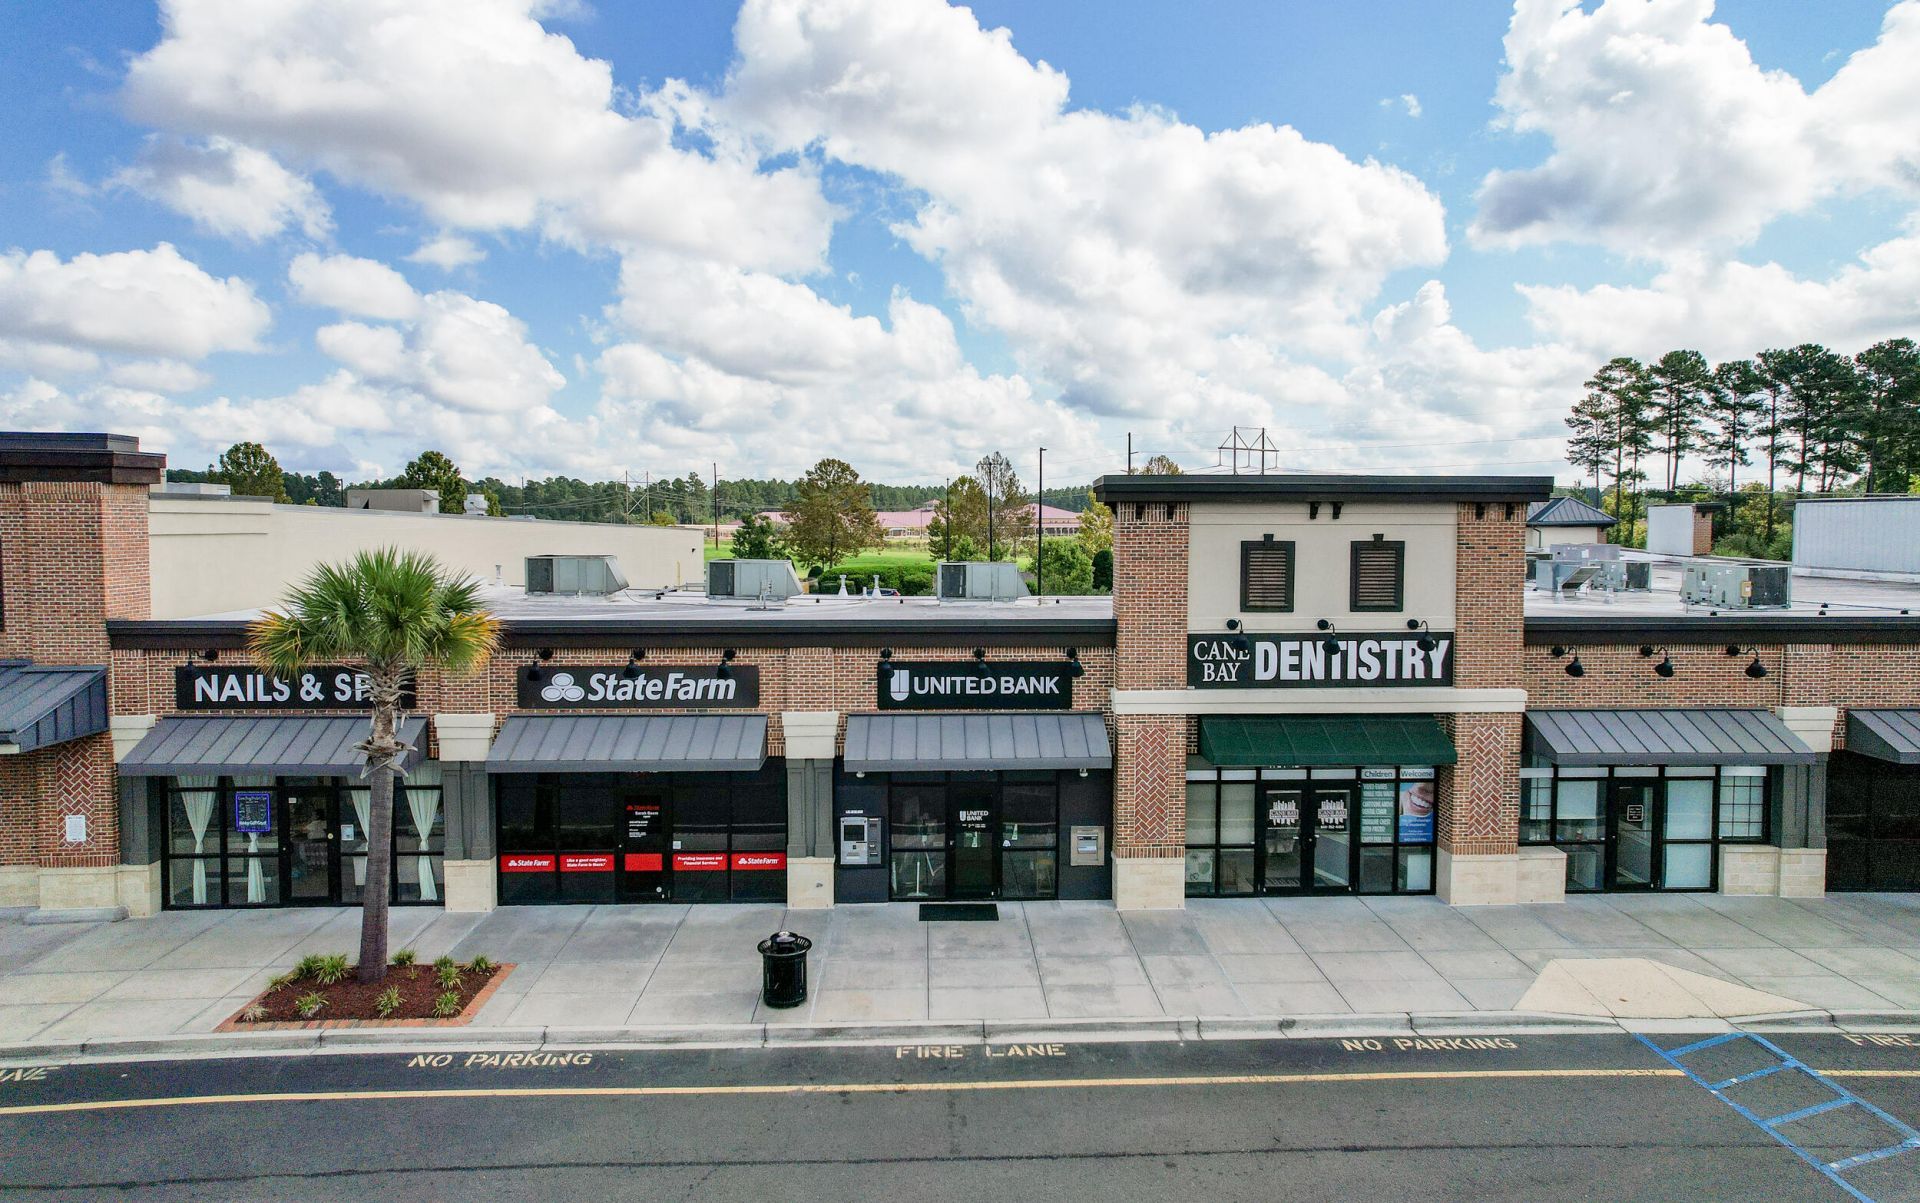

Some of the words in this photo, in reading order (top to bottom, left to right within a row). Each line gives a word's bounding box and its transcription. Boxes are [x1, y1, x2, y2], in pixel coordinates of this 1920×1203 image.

[1193, 640, 1250, 661] CANE
[1254, 639, 1450, 680] DENTISTRY
[1202, 662, 1241, 682] BAY
[195, 673, 291, 702] NAILS
[299, 673, 325, 702] &
[334, 672, 372, 702] SP
[913, 675, 997, 695] UNITED
[1000, 676, 1060, 695] BANK
[1364, 770, 1393, 778] Children
[1400, 770, 1433, 778] Welcome
[896, 1045, 964, 1059] FIRE
[984, 1043, 1067, 1057] LANE
[1341, 1038, 1383, 1051] NO
[1393, 1037, 1519, 1050] PARKING
[407, 1054, 453, 1068] NO
[464, 1052, 593, 1067] PARKING
